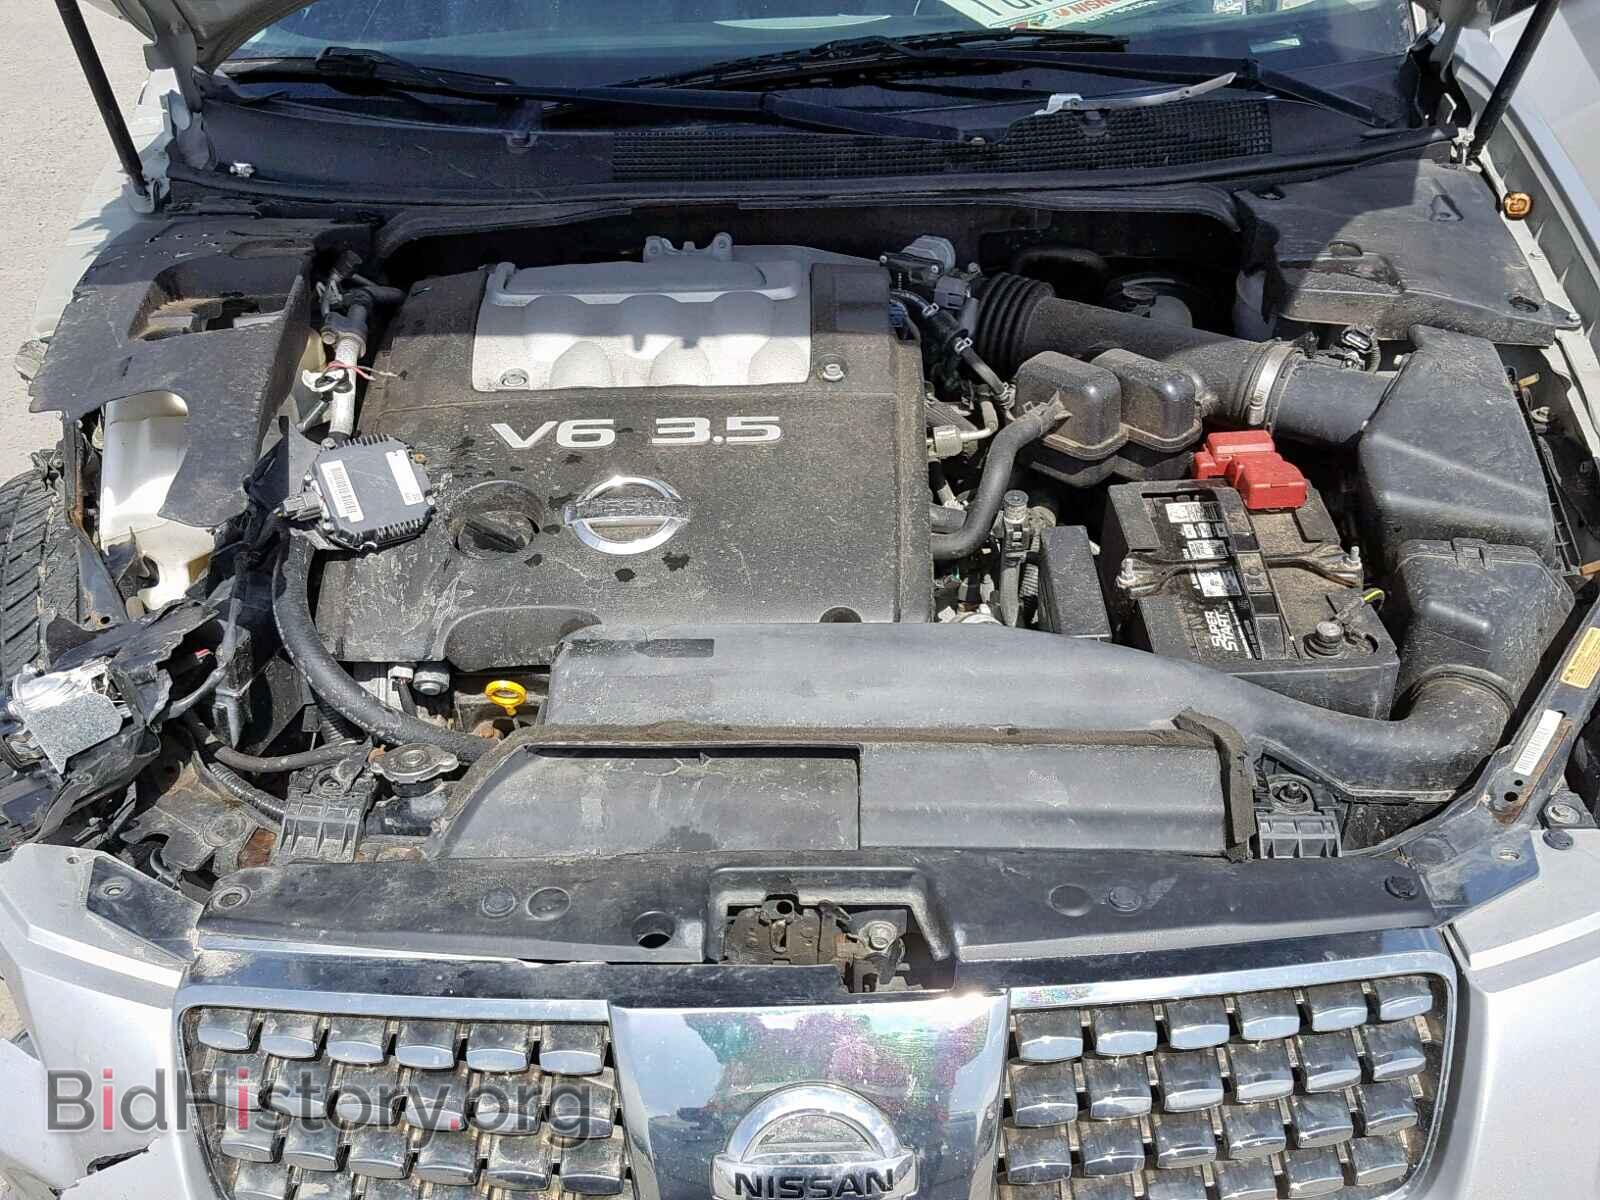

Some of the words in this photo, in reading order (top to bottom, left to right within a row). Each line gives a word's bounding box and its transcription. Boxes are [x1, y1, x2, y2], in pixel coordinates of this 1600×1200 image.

[491, 419, 616, 449] V6
[651, 416, 782, 446] 3.5
[1204, 610, 1222, 647] SUPER
[734, 1168, 895, 1199] NISSAN
